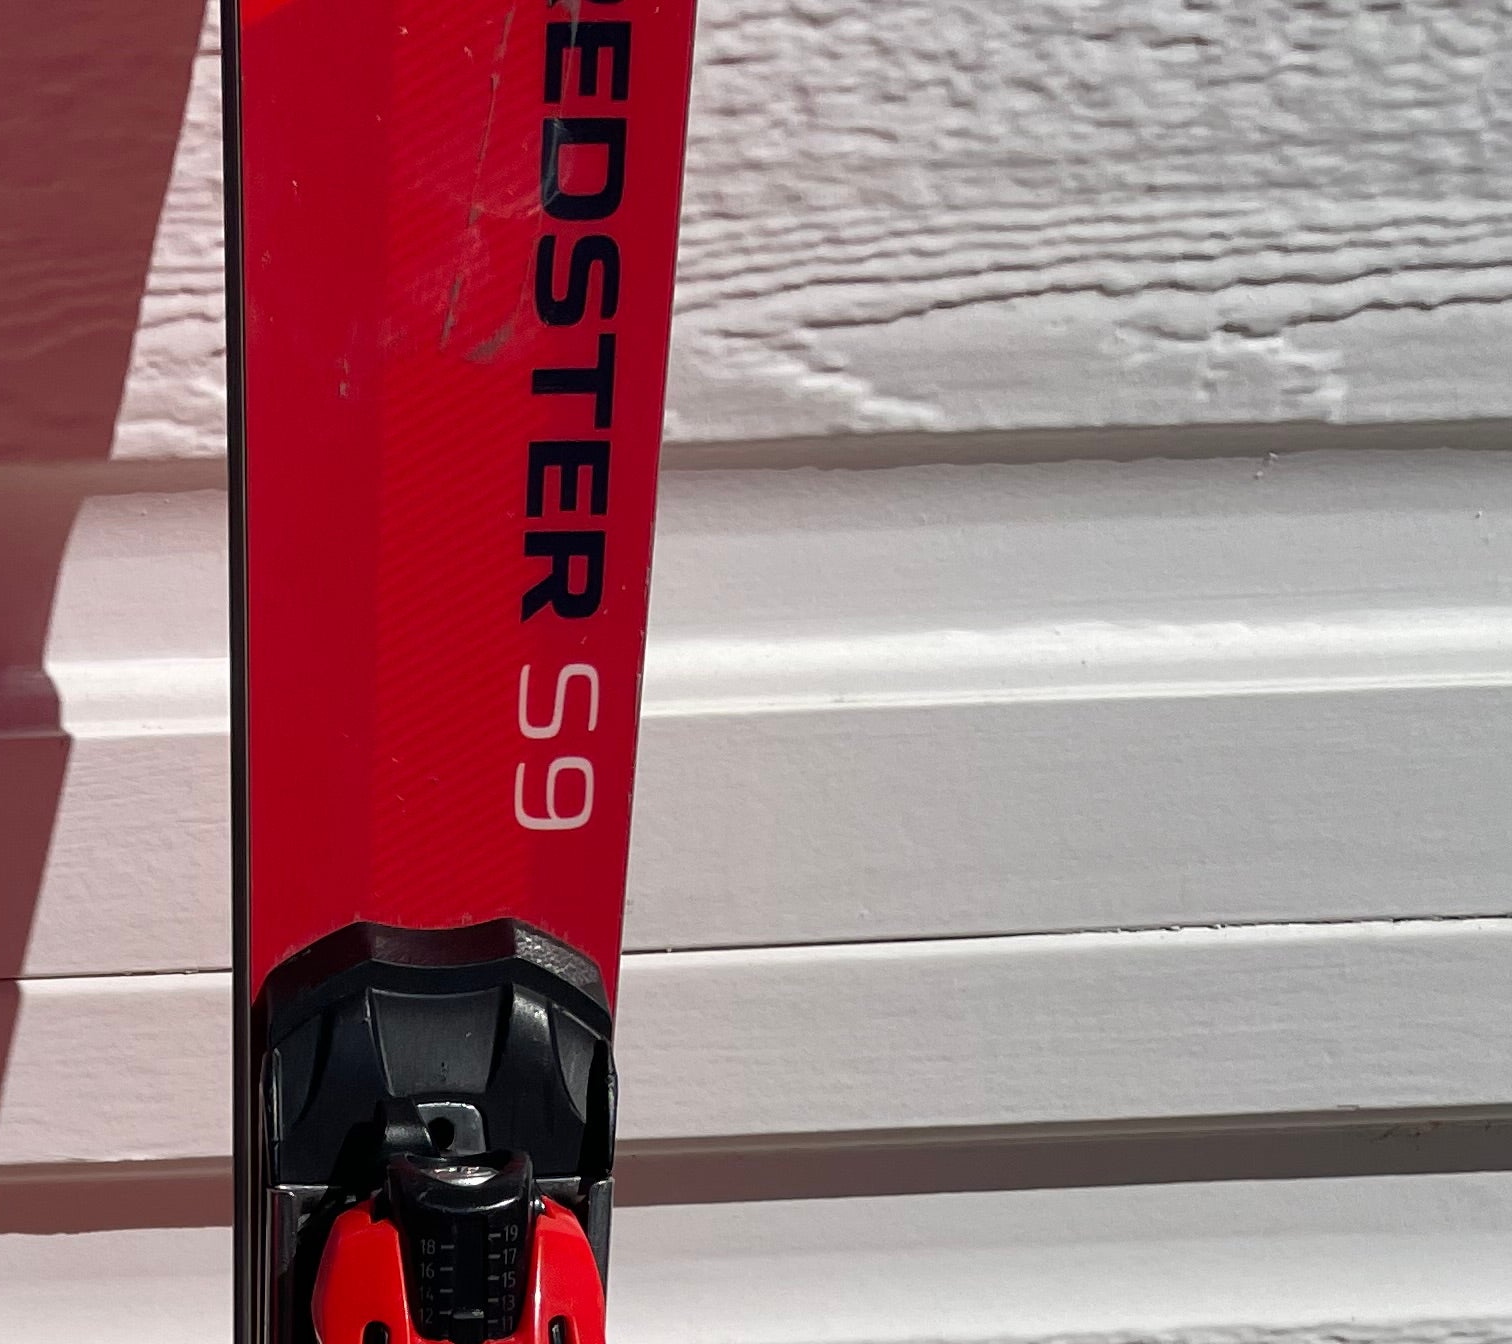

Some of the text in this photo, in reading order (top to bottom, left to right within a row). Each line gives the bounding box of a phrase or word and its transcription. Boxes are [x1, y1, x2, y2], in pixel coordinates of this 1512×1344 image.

[515, 0, 631, 831] EDSTER S9
[503, 1224, 519, 1242] 19
[420, 1239, 436, 1255] 18
[502, 1248, 517, 1265] 17
[420, 1262, 435, 1279] 16
[502, 1271, 516, 1288] 15
[419, 1308, 433, 1324] 12
